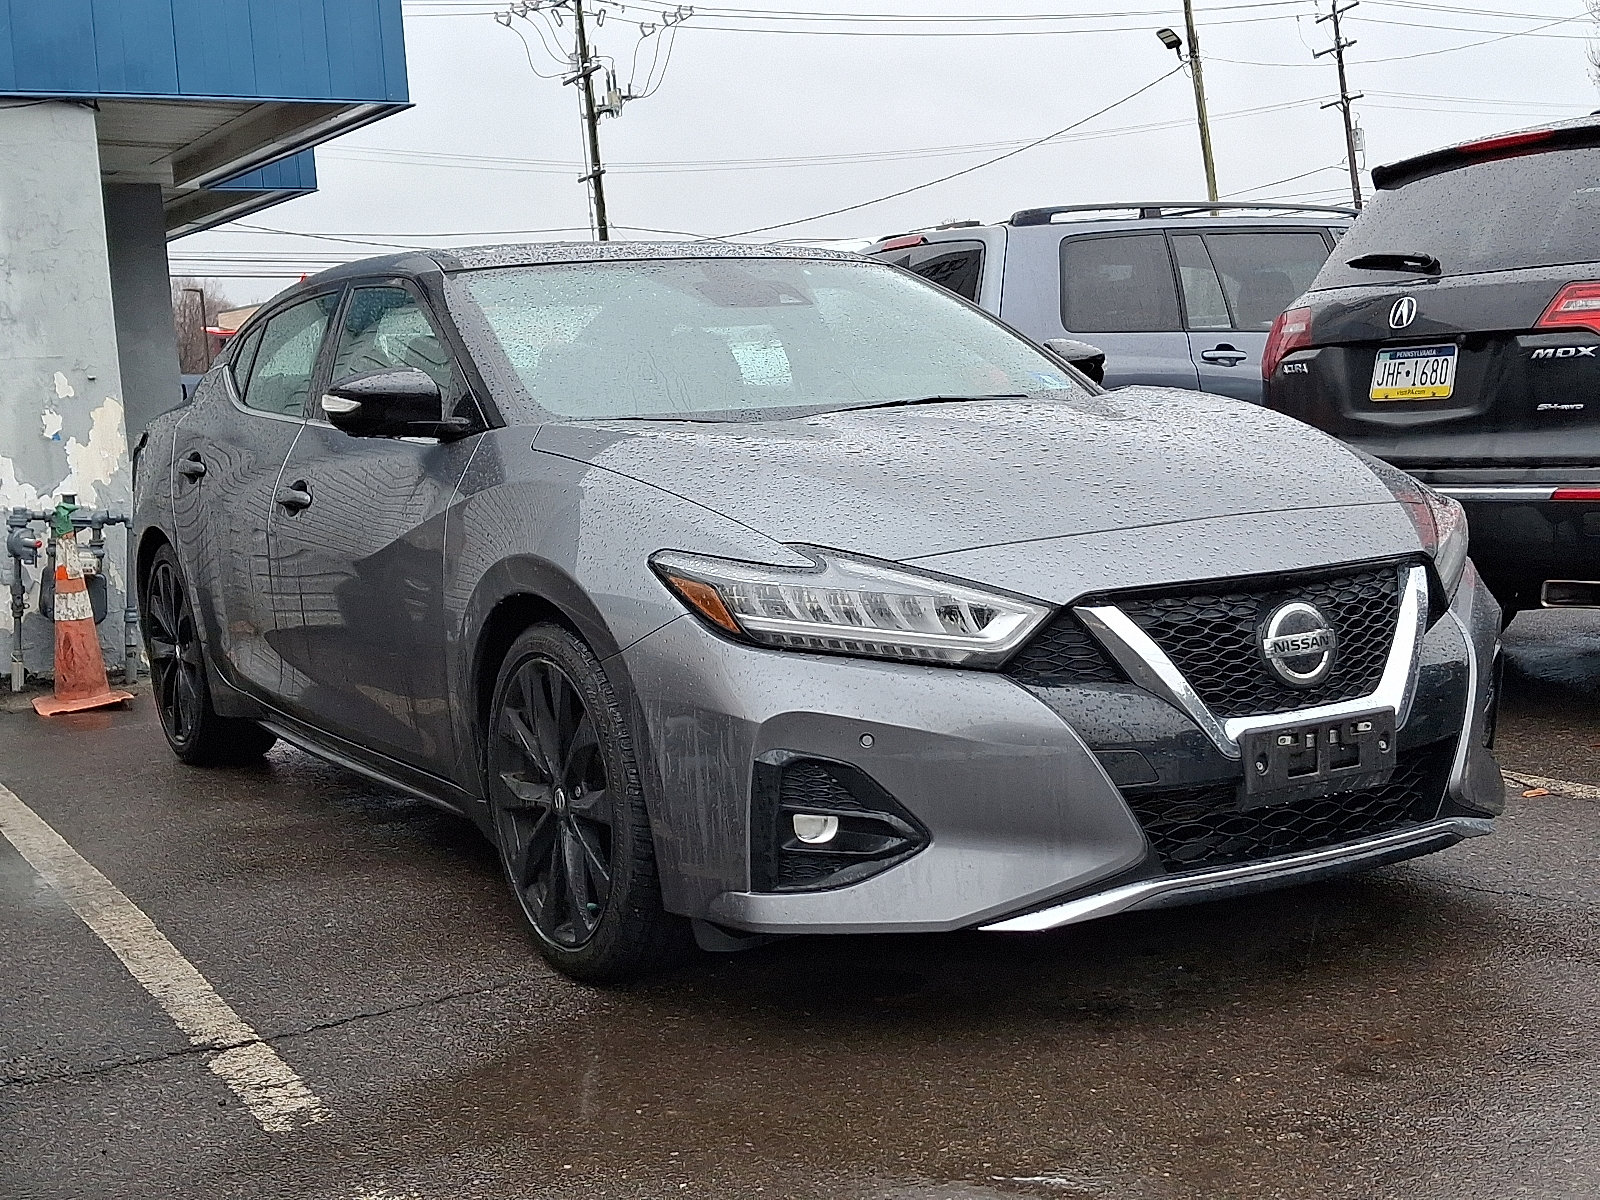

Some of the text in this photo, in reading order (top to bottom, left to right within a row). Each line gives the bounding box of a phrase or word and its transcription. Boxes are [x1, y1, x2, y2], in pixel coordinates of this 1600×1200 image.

[1396, 349, 1436, 358] PENNSYLVANIA
[1530, 346, 1599, 359] MDX
[1272, 634, 1329, 654] NISSAN
